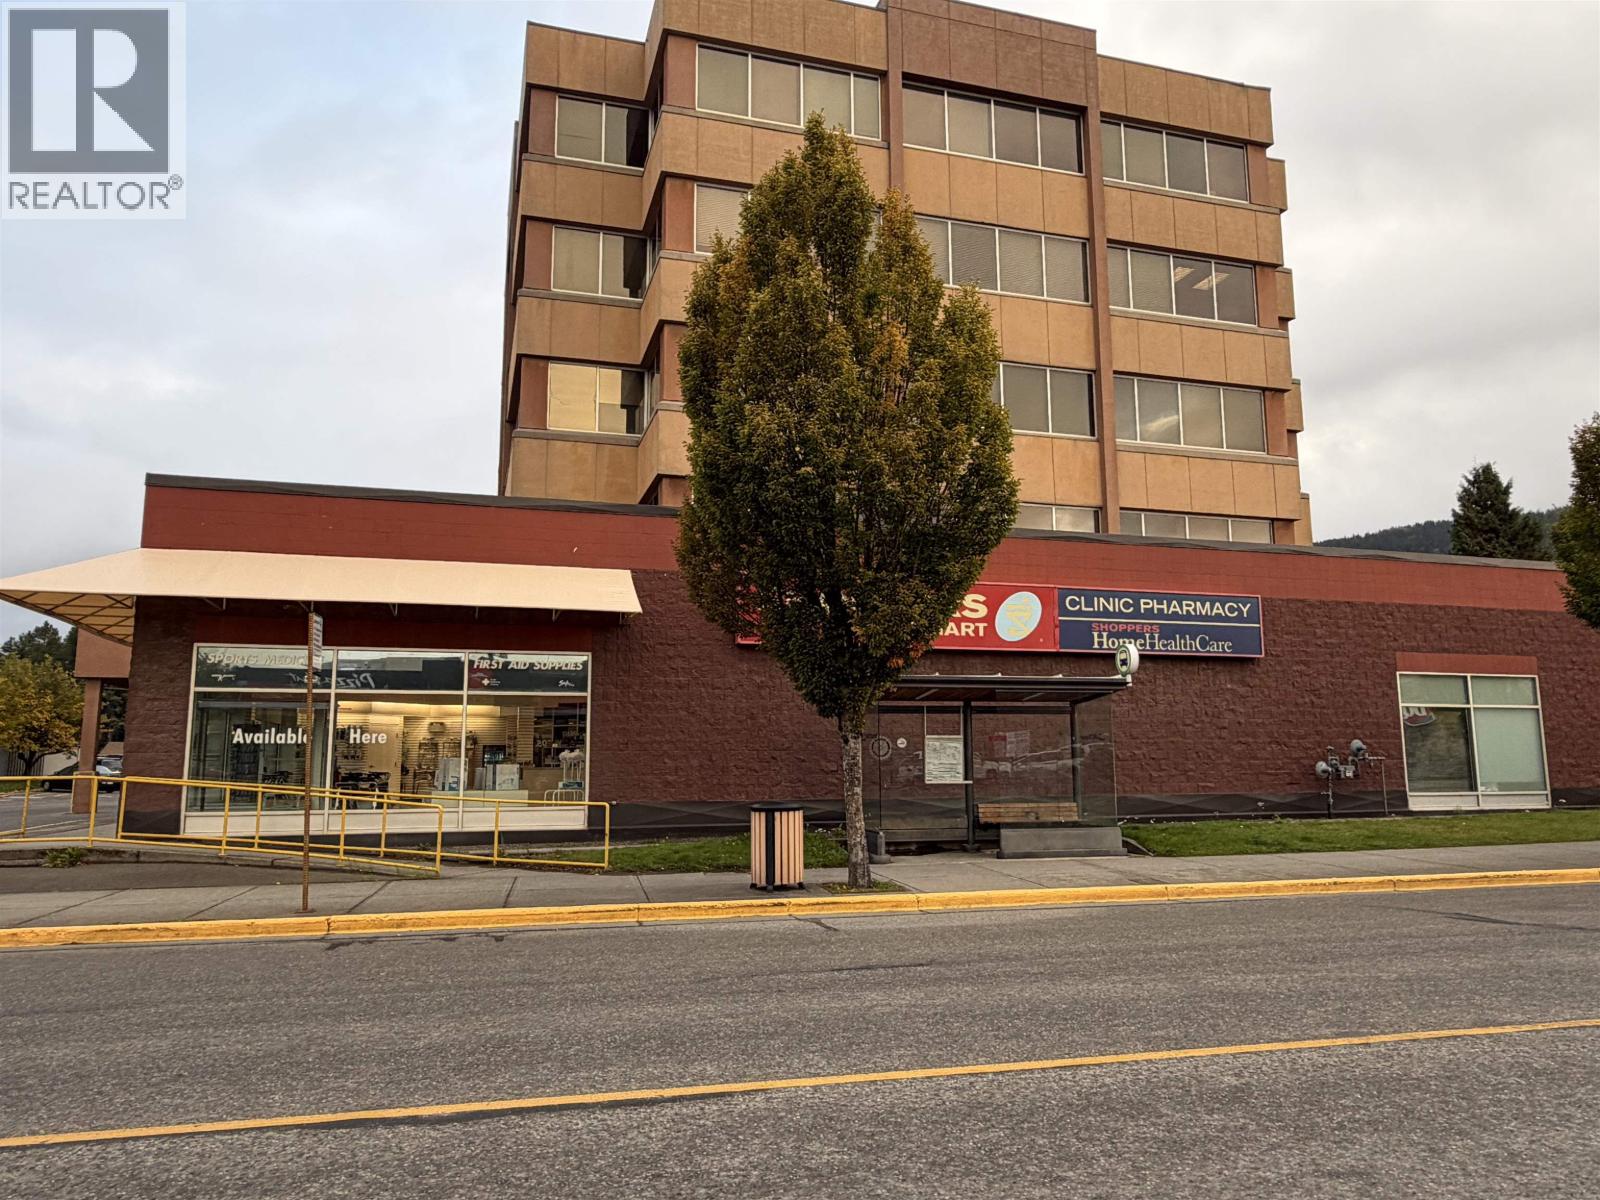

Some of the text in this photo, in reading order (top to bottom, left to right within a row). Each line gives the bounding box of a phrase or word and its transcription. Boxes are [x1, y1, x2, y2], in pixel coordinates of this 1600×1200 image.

[1065, 595, 1251, 618] CLINIC PHARMACY
[939, 621, 988, 637] ART
[1091, 623, 1160, 633] SHOPPERS
[473, 659, 583, 671] FIRST AID SUPPLIES
[350, 728, 387, 744] Here
